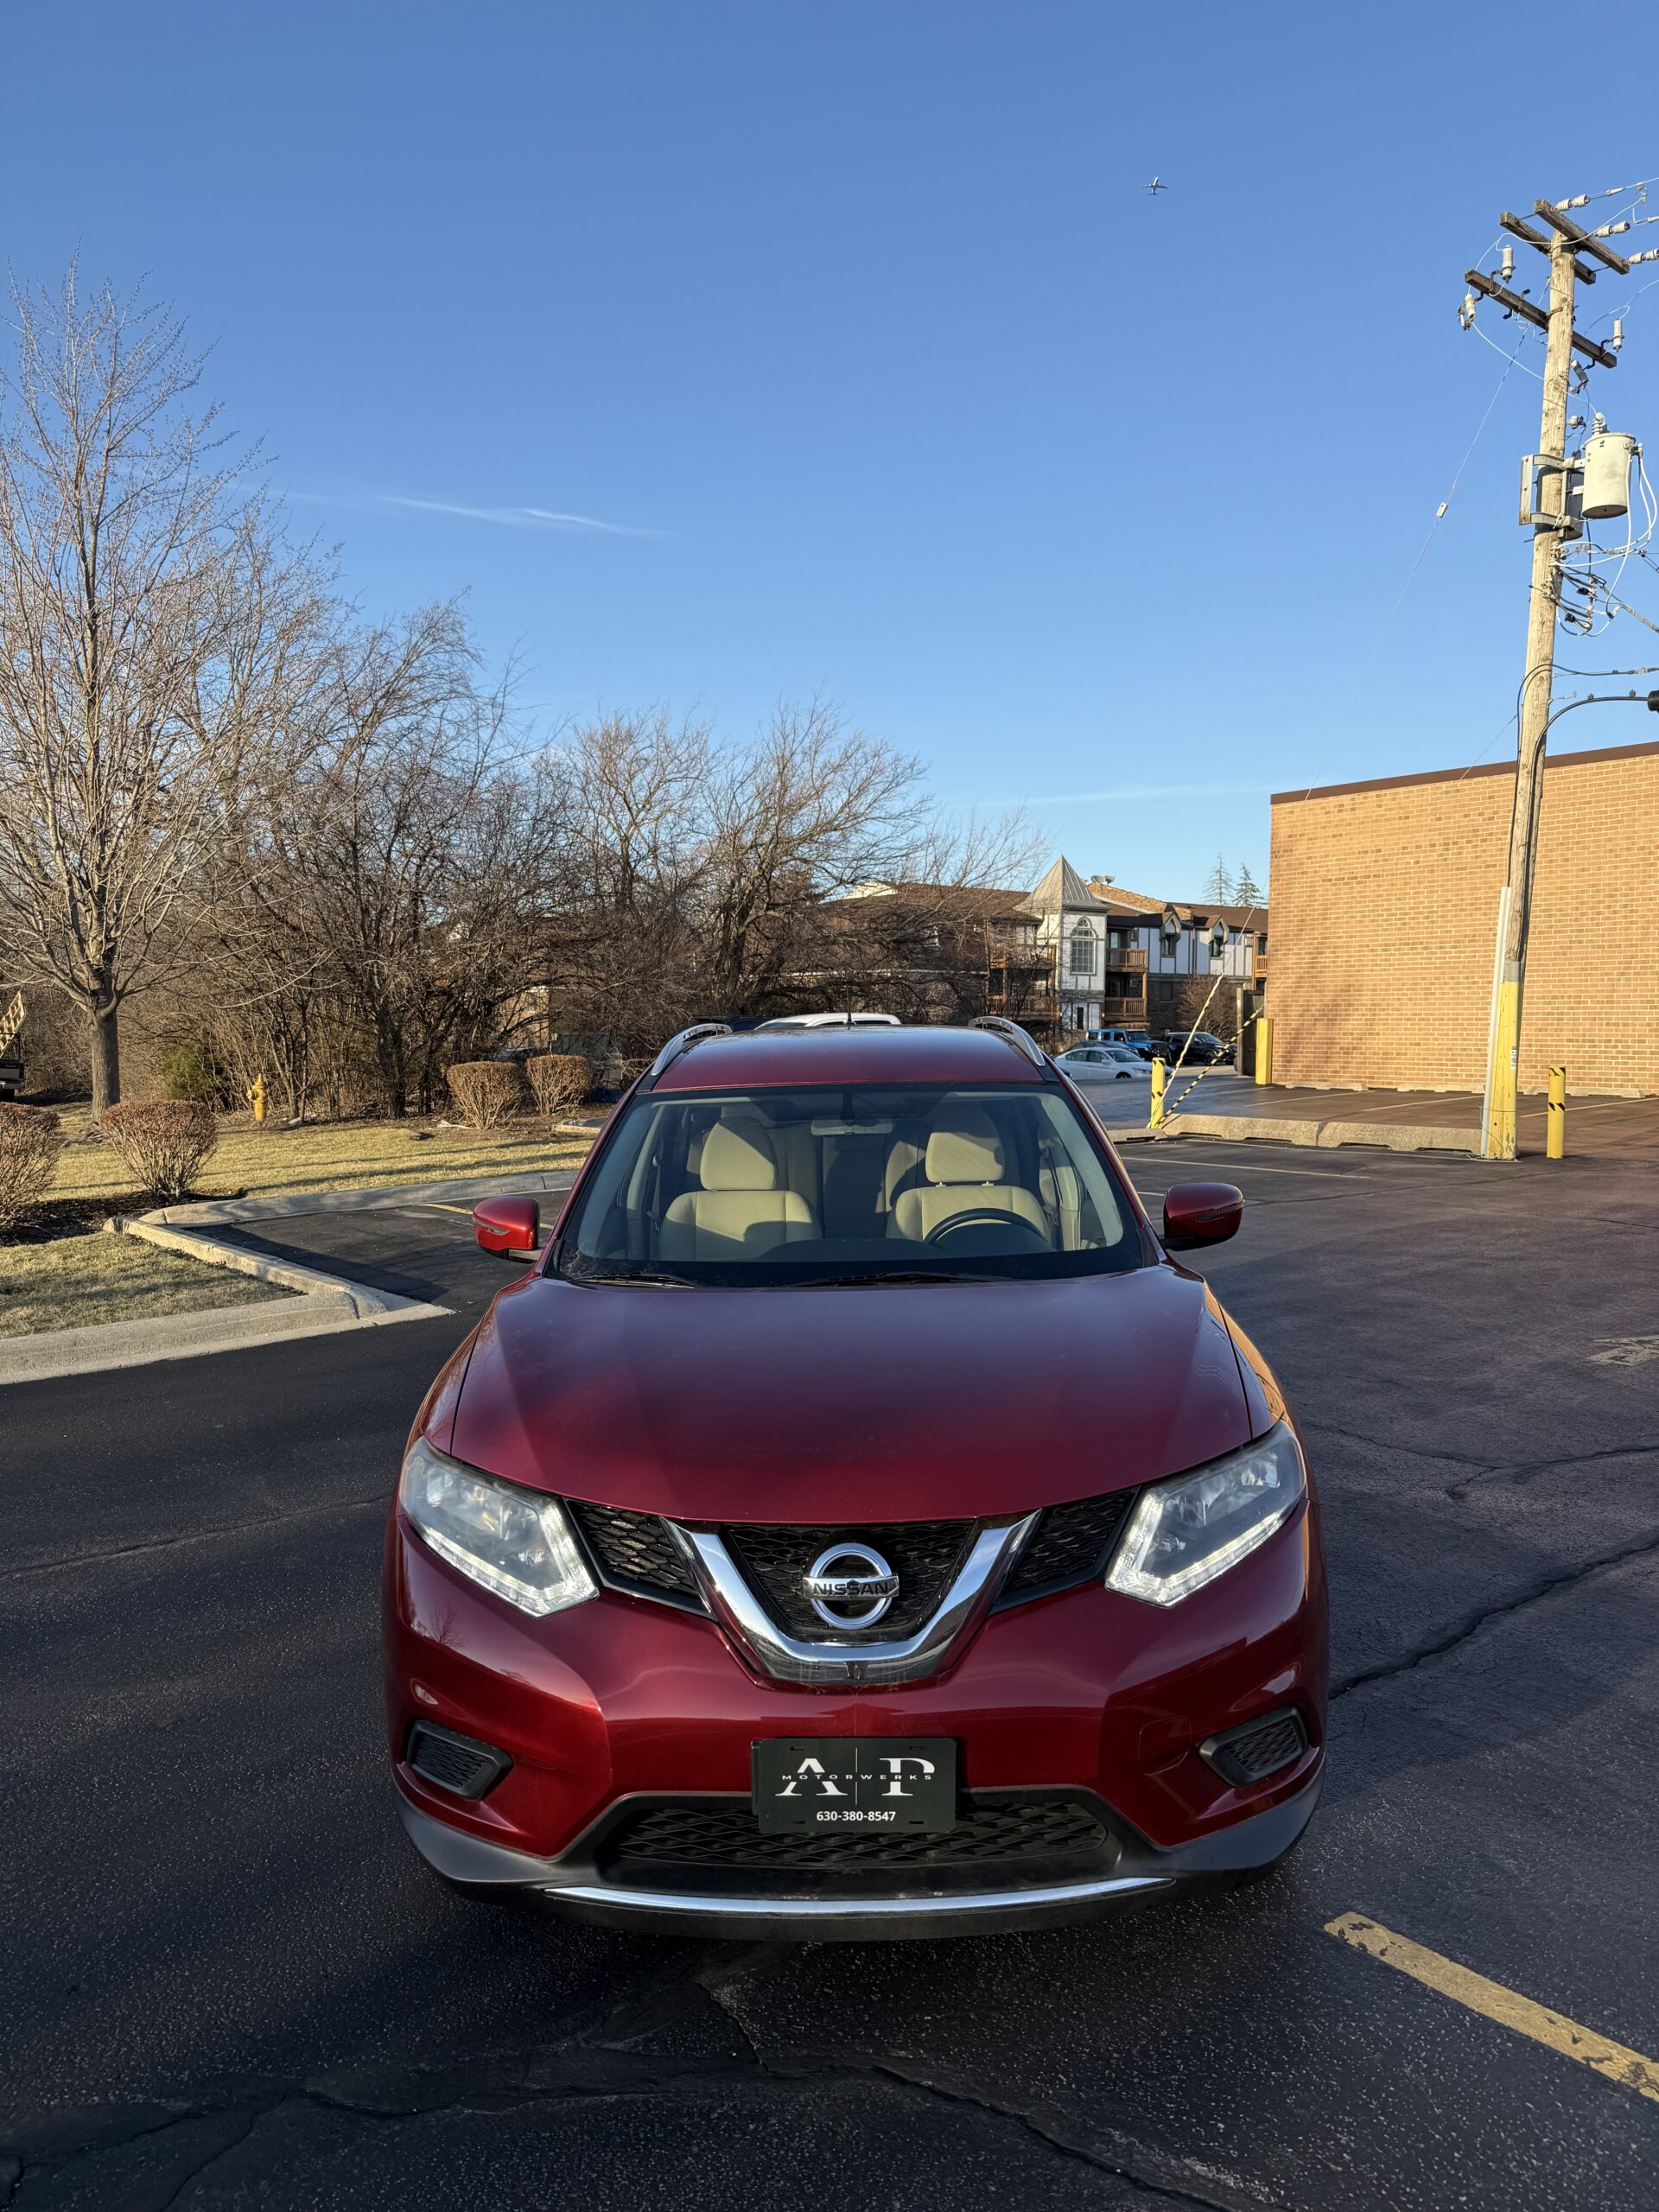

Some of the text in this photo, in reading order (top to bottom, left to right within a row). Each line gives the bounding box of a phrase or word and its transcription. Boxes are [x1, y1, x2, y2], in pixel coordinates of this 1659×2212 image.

[813, 1582, 888, 1596] NISSAN
[775, 1758, 936, 1796] A P
[816, 1810, 897, 1821] 630-380-8547
